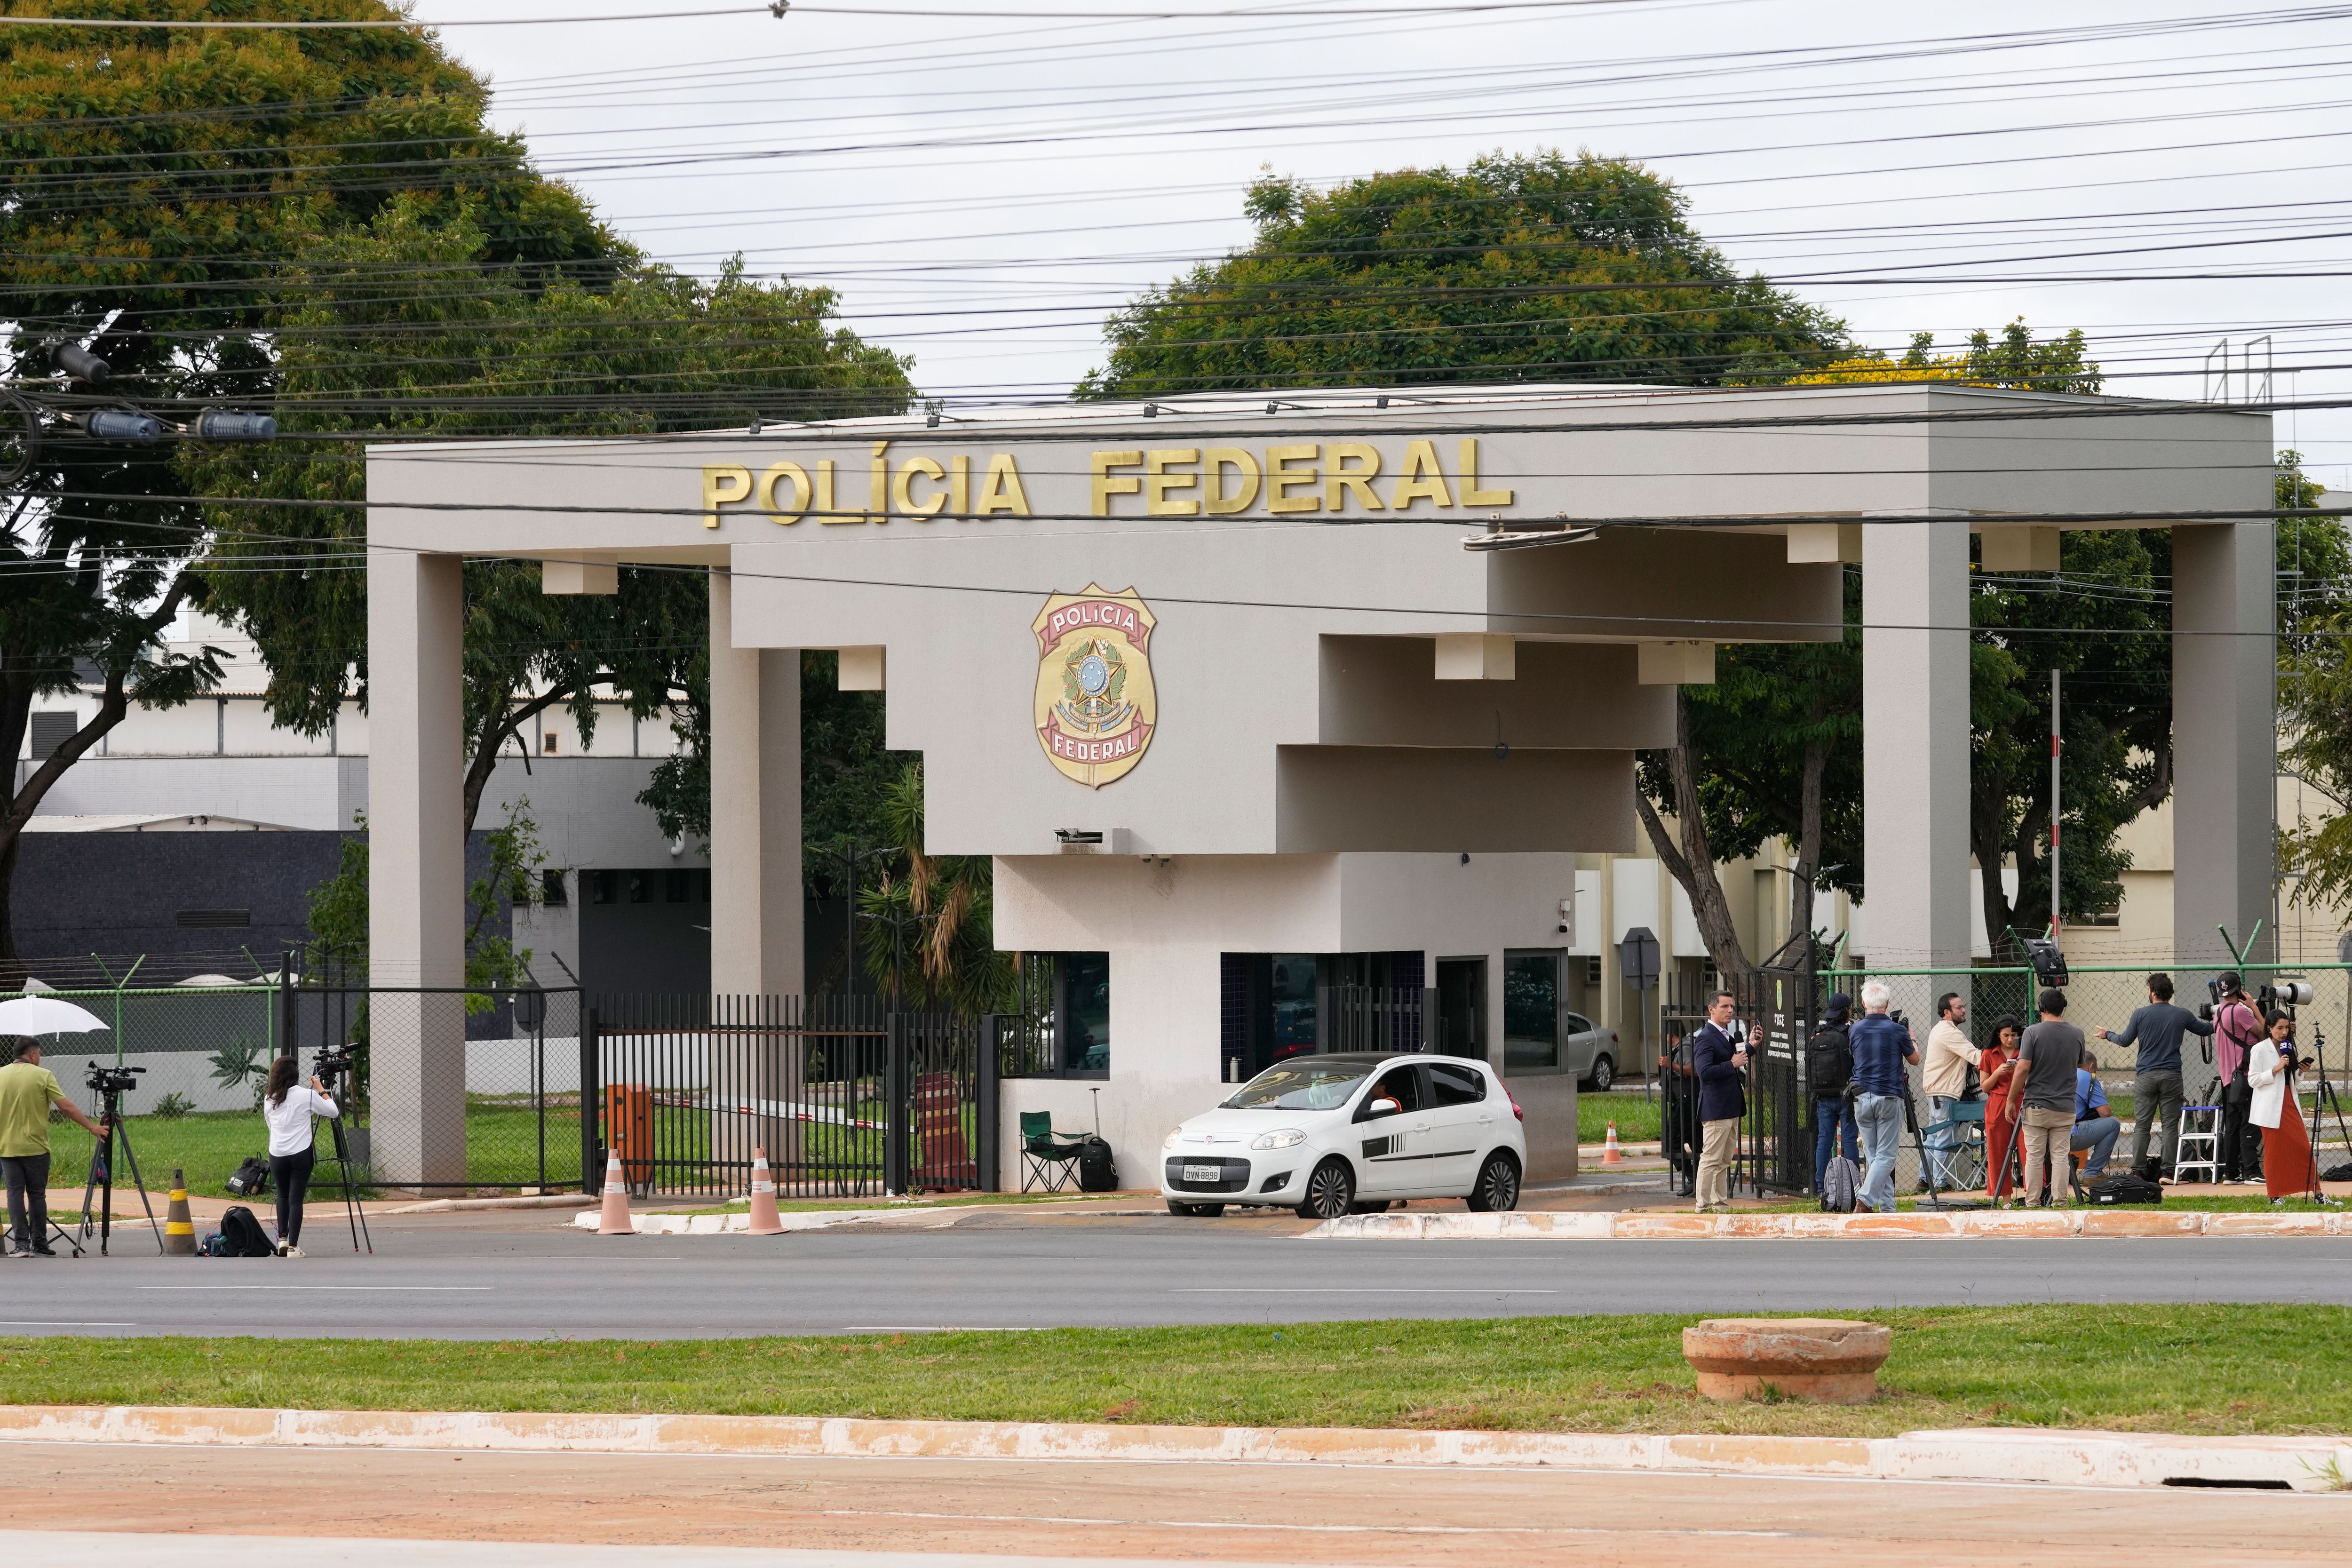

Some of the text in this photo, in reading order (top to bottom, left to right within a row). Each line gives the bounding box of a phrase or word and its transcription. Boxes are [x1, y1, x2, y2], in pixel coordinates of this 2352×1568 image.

[702, 438, 1514, 528] POLÍCIA FEDERAL
[1054, 732, 1137, 761] FEDERAL
[1186, 1171, 1218, 1179] OVN-8898
